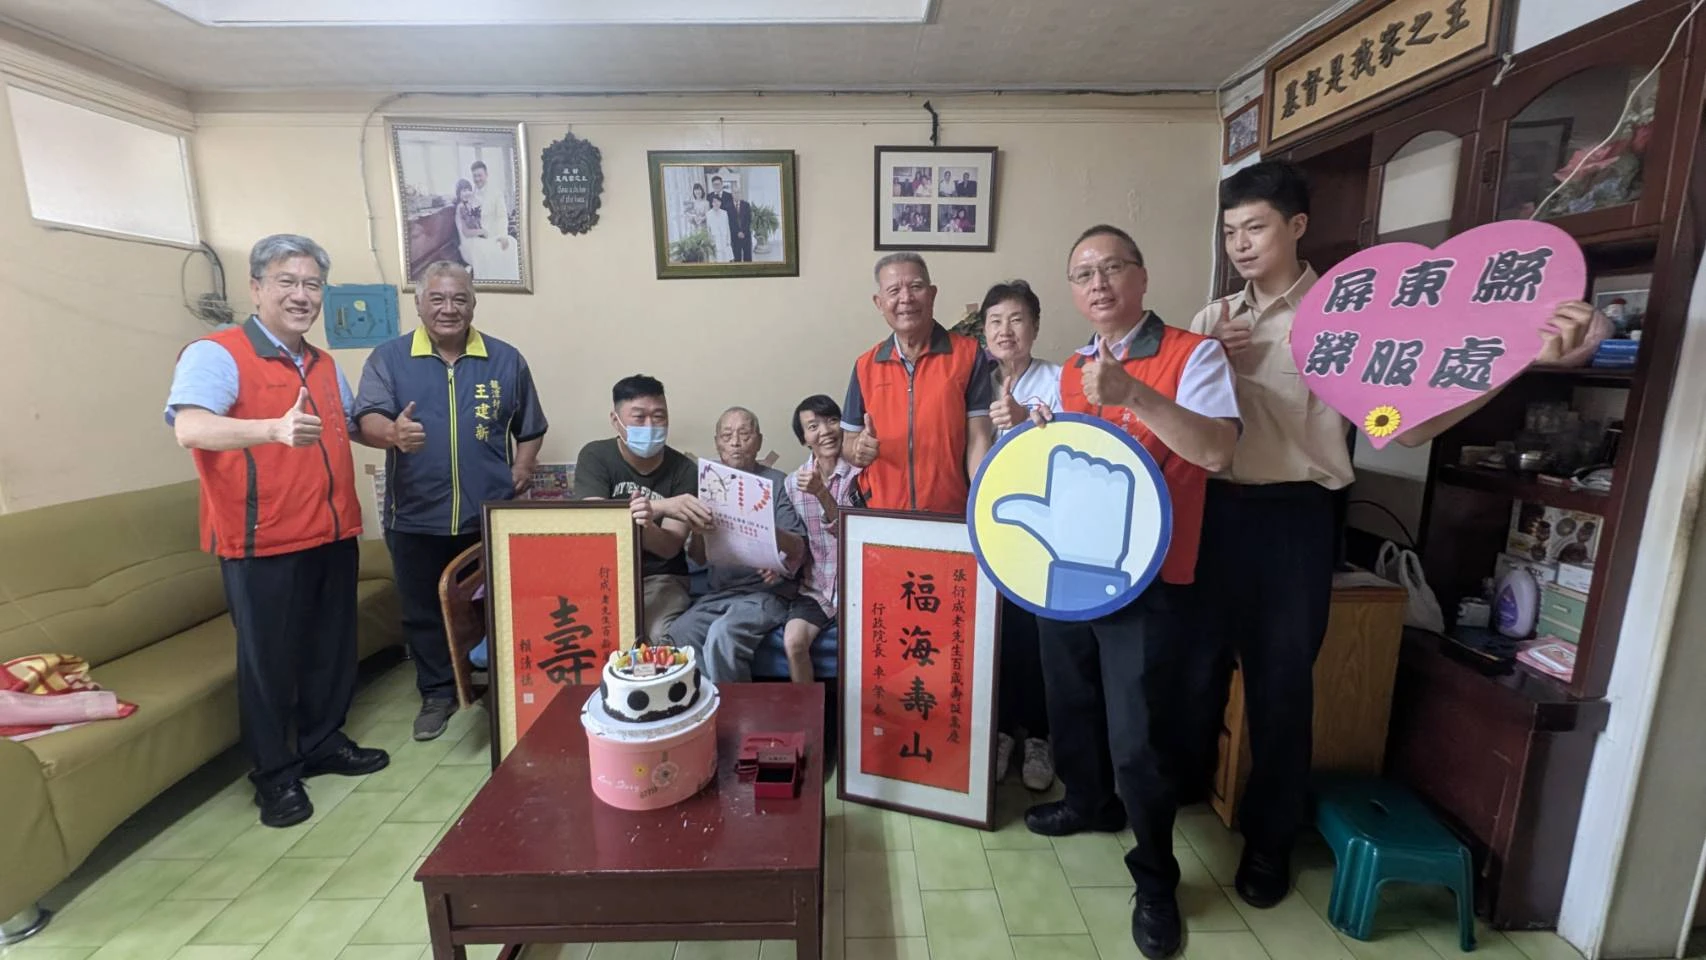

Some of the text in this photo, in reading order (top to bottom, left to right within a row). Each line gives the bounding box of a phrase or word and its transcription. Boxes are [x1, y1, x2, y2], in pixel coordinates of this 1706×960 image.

[1323, 248, 1554, 313] 屏東縣
[1304, 331, 1506, 391] 榮服處
[474, 383, 490, 442] 王建新
[537, 595, 597, 686] 壽
[898, 570, 941, 764] 福海壽山
